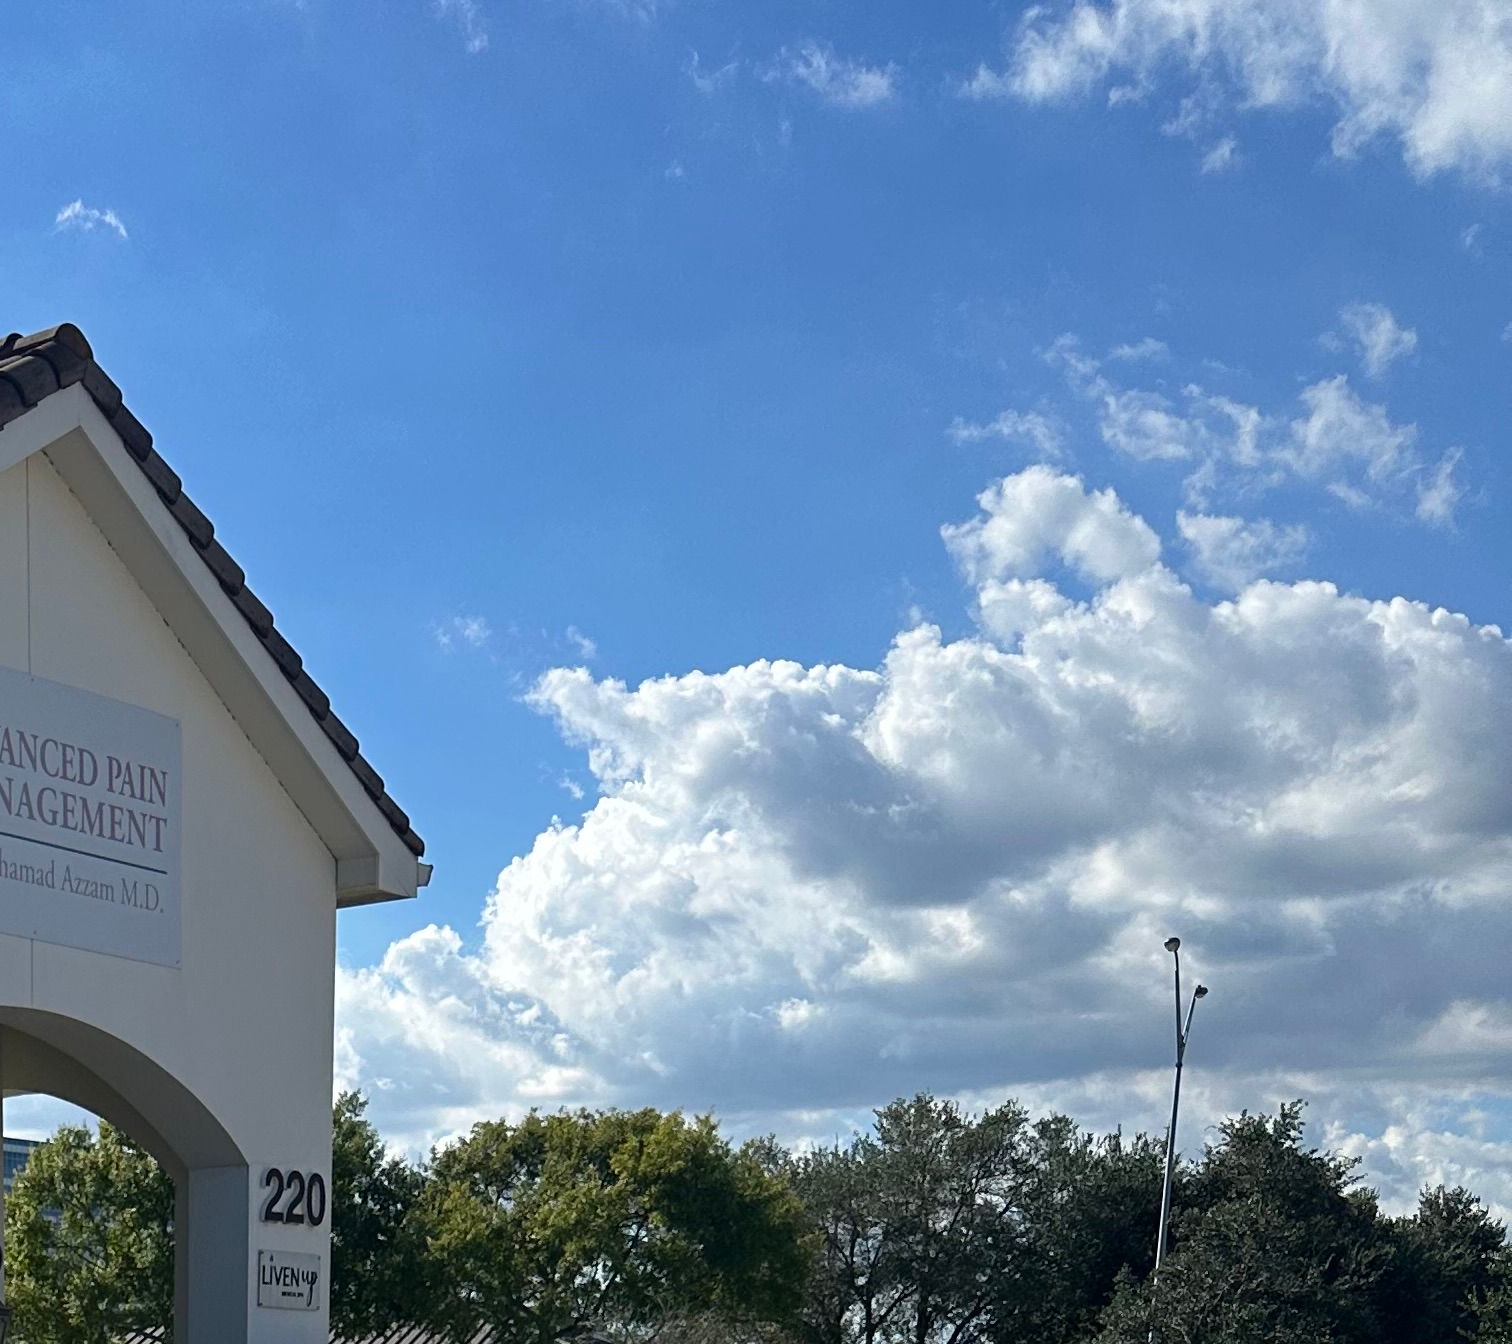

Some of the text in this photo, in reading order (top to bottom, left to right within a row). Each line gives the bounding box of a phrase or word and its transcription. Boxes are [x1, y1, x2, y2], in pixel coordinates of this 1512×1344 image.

[106, 755, 169, 807] PAIN
[61, 865, 115, 903] Azzam
[120, 877, 165, 914] M.D.
[264, 1167, 326, 1227] 220
